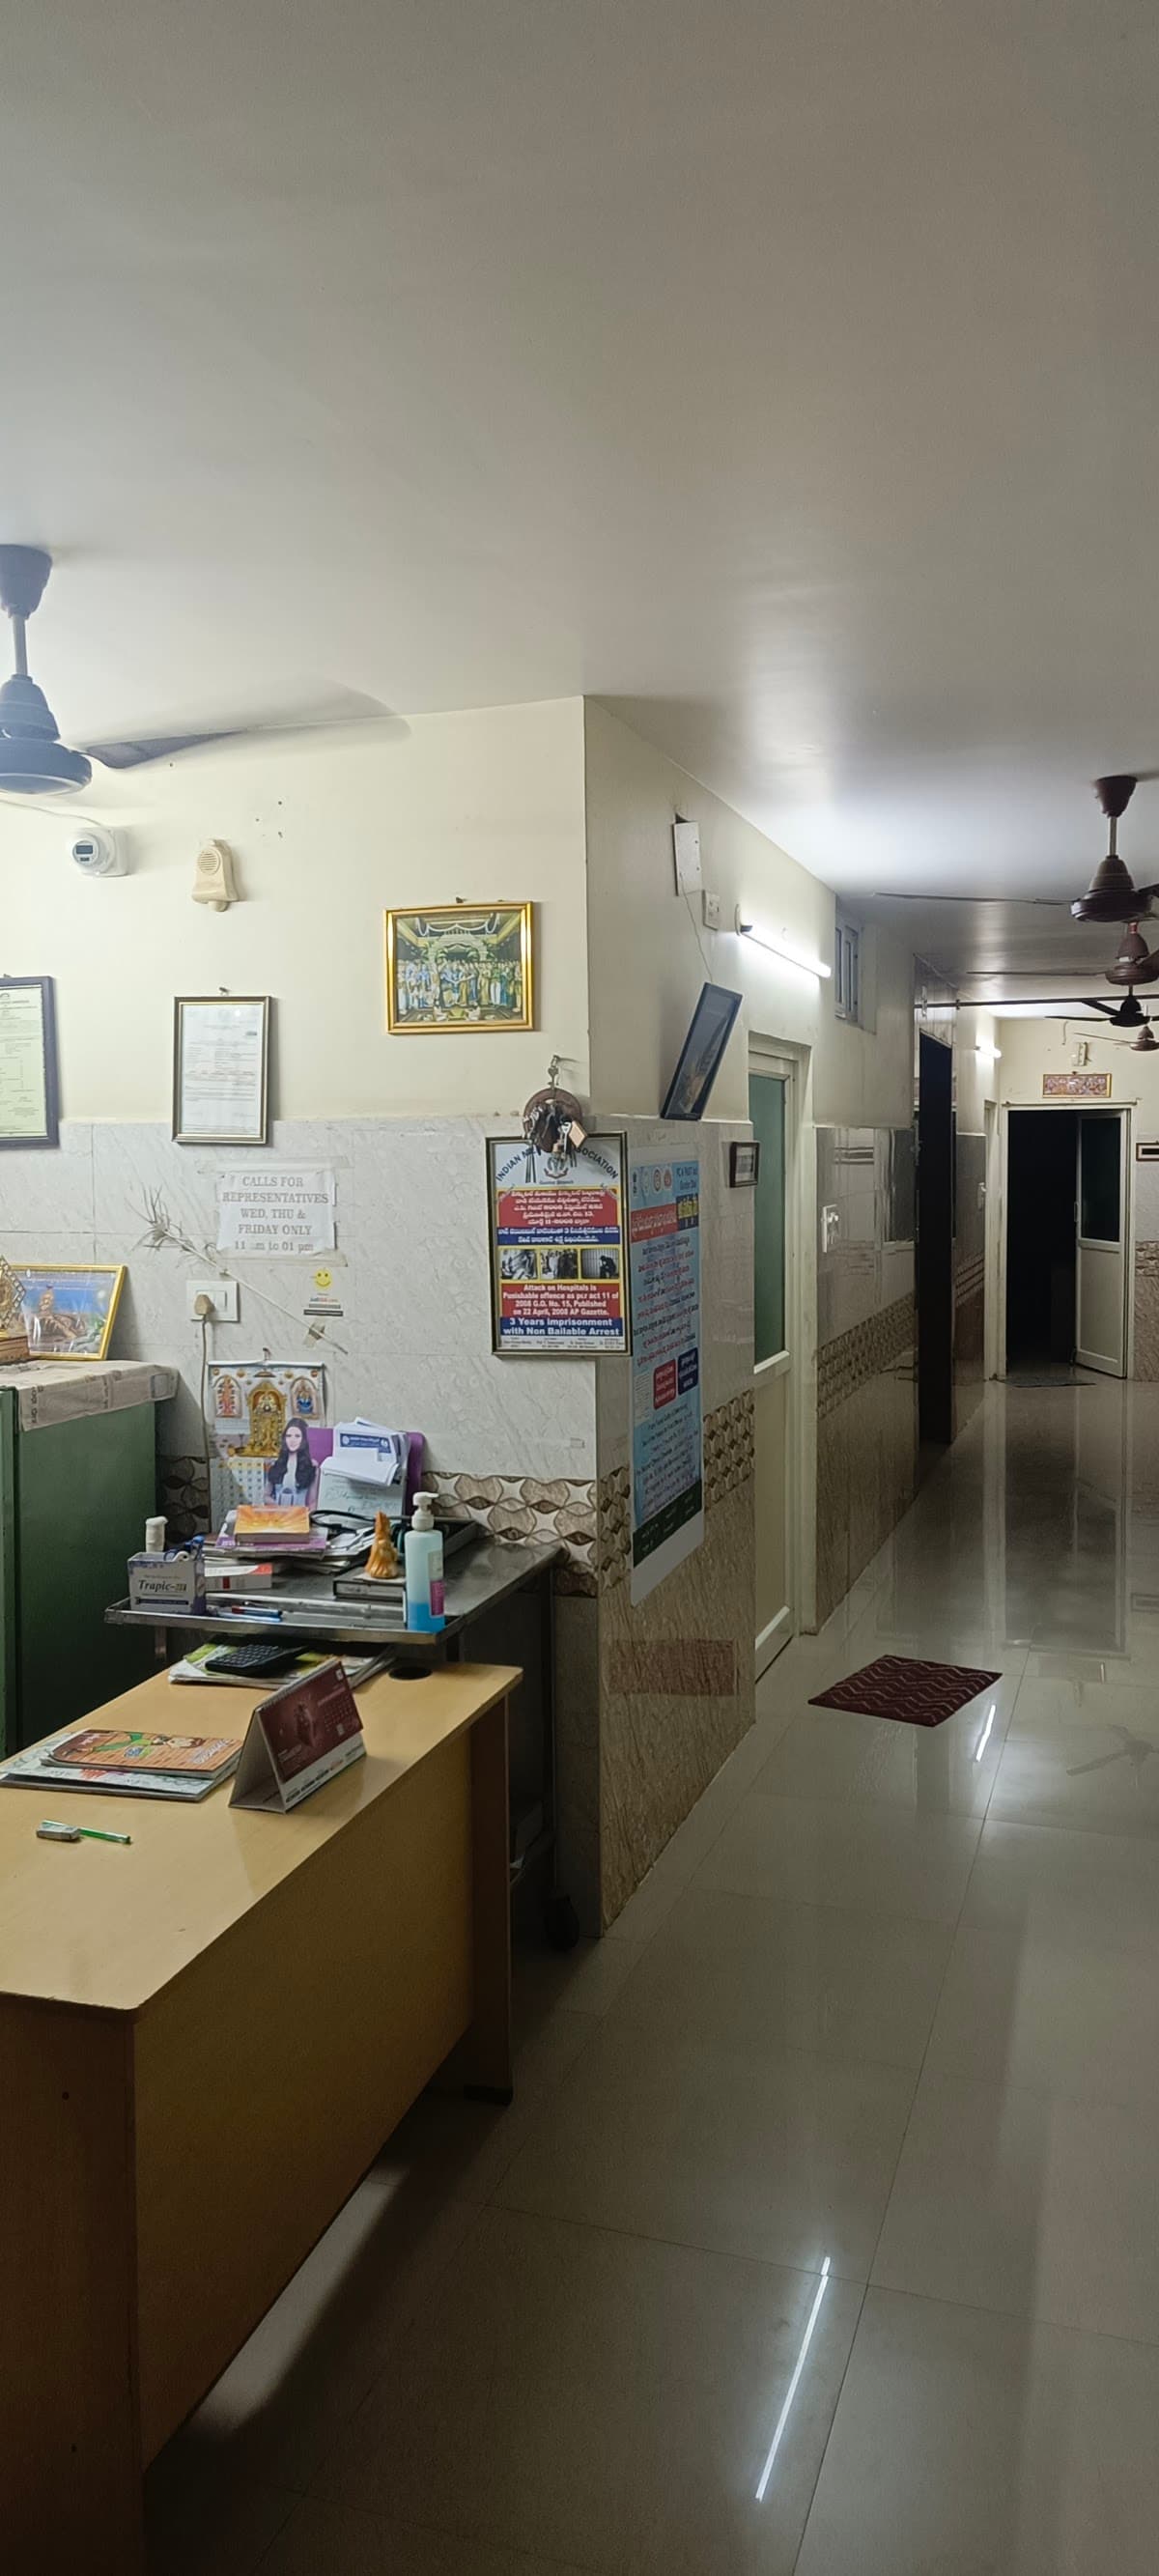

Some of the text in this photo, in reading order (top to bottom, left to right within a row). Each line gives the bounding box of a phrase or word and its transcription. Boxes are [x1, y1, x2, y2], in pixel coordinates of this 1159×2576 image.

[495, 1155, 523, 1182] INDIAN
[576, 1146, 619, 1178] SOCIATION
[241, 1175, 304, 1187] CALLS FOR
[222, 1192, 329, 1203] REPRESENTATIVES
[240, 1208, 306, 1220] WED, THU &
[238, 1224, 313, 1235] FRIDAY ONLY
[235, 1240, 245, 1250] 11
[269, 1242, 279, 1251] to
[281, 1241, 294, 1251] 01
[297, 1243, 314, 1253] pm
[557, 1284, 589, 1292] Hospitals
[533, 1308, 551, 1316] April,
[518, 1317, 545, 1326] Years
[588, 1327, 619, 1336] Arrest
